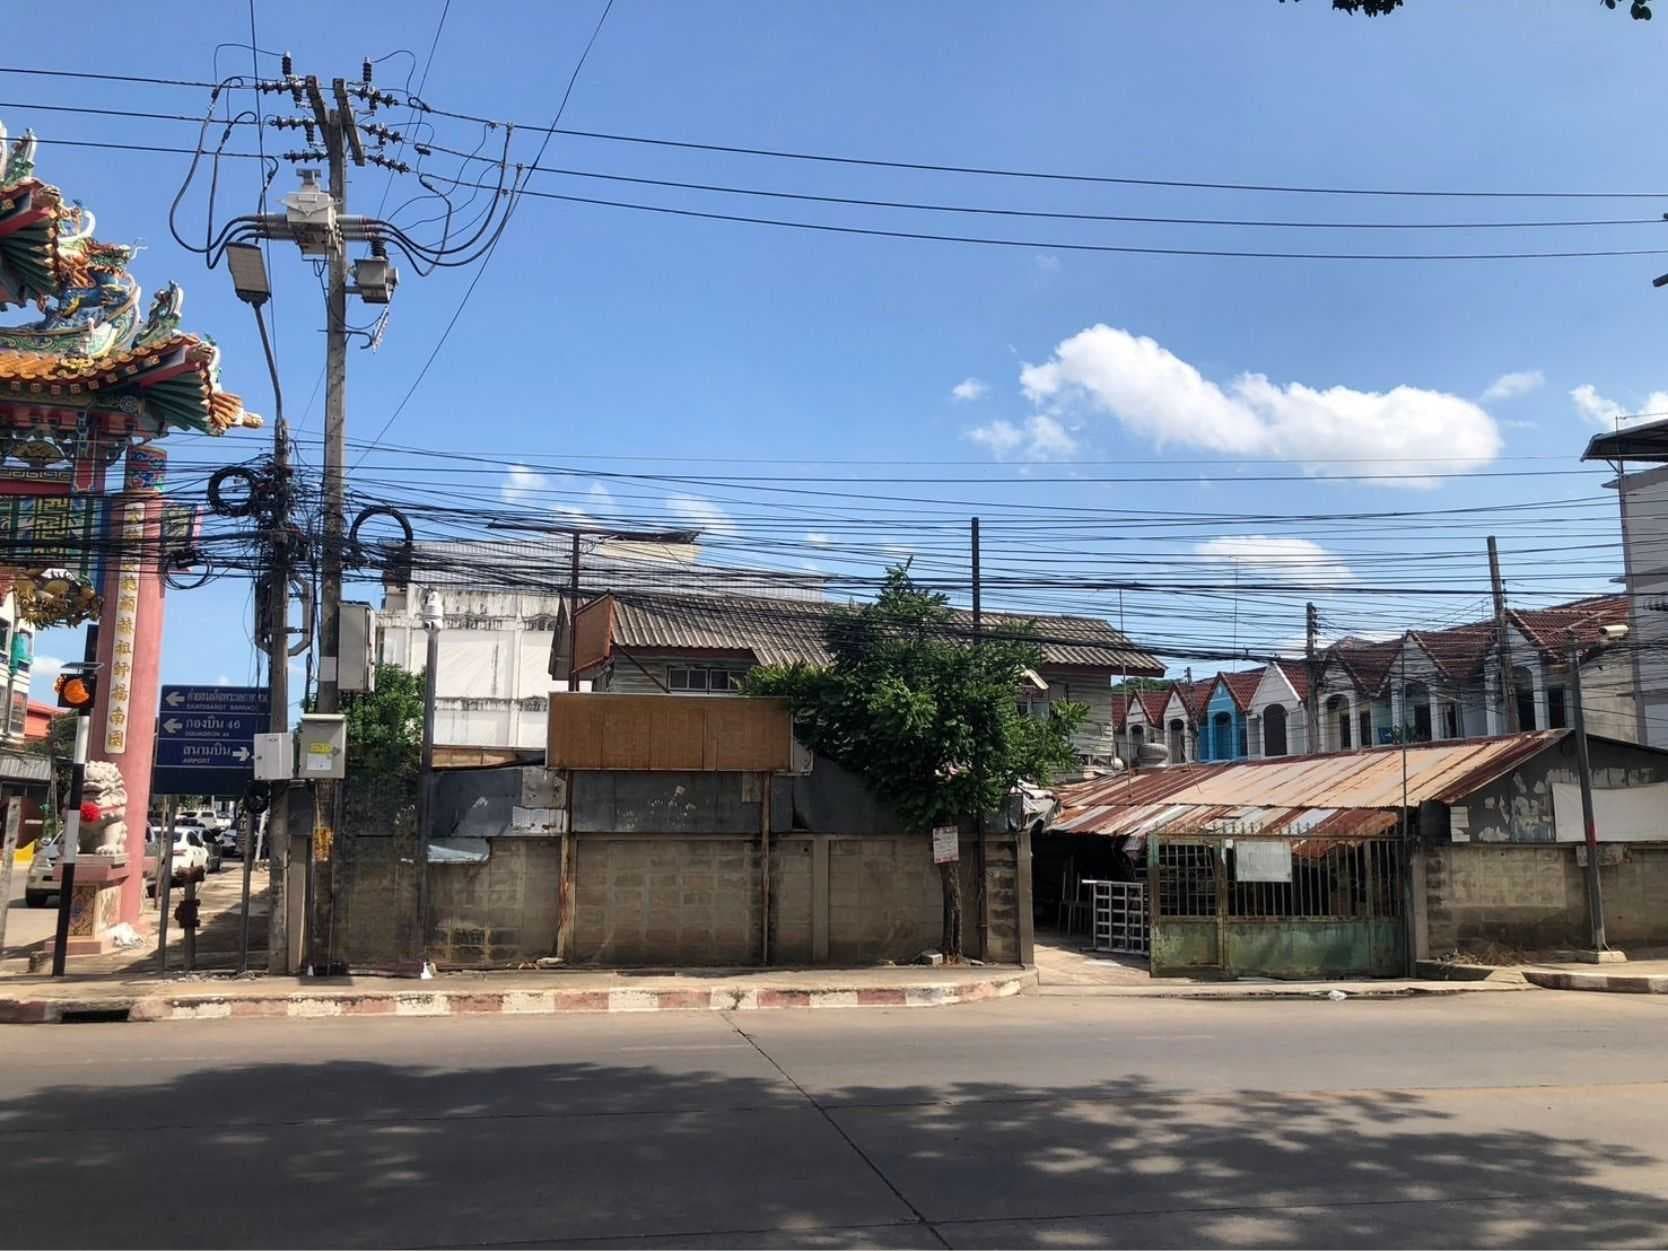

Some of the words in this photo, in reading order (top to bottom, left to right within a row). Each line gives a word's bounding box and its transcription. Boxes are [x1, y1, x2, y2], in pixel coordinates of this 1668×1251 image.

[185, 716, 224, 729] กองบิน
[226, 719, 241, 729] 46
[183, 742, 231, 756] สนามบิน
